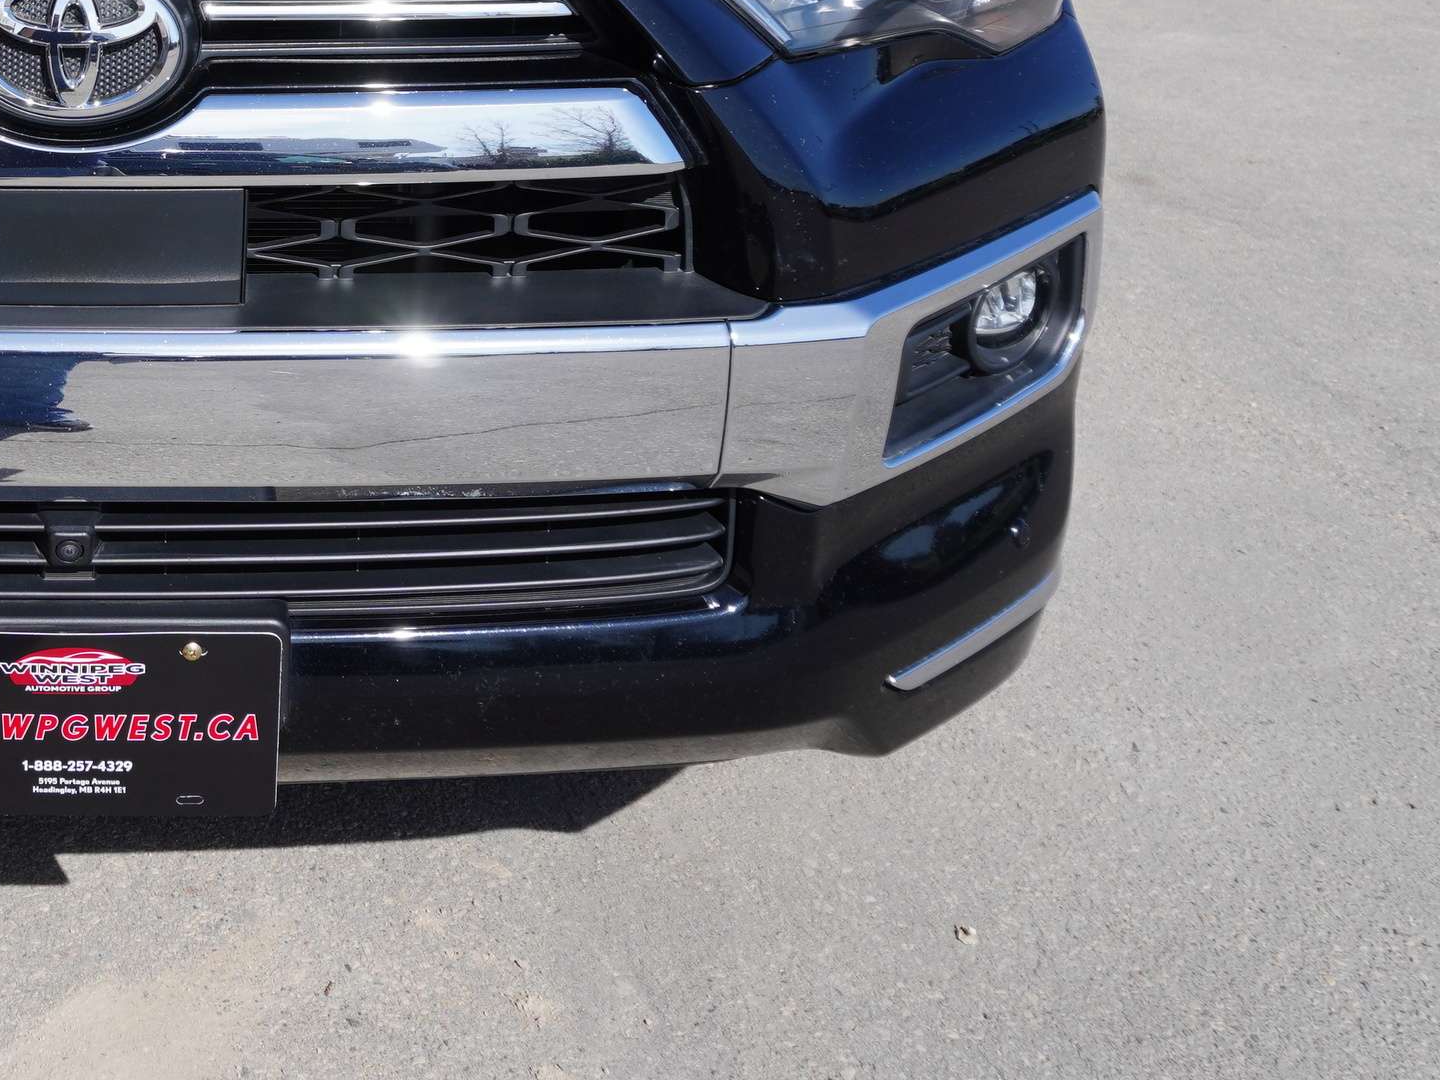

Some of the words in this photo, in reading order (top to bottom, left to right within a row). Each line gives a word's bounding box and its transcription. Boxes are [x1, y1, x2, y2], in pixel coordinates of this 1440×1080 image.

[32, 674, 112, 684] WEST
[21, 760, 133, 772] 1-888-257-4329
[38, 777, 58, 785] 5195
[59, 777, 90, 786] Portage
[91, 777, 120, 785] Avenue
[79, 786, 93, 794] MB
[94, 786, 112, 794] R4H
[113, 786, 127, 794] 1E1
